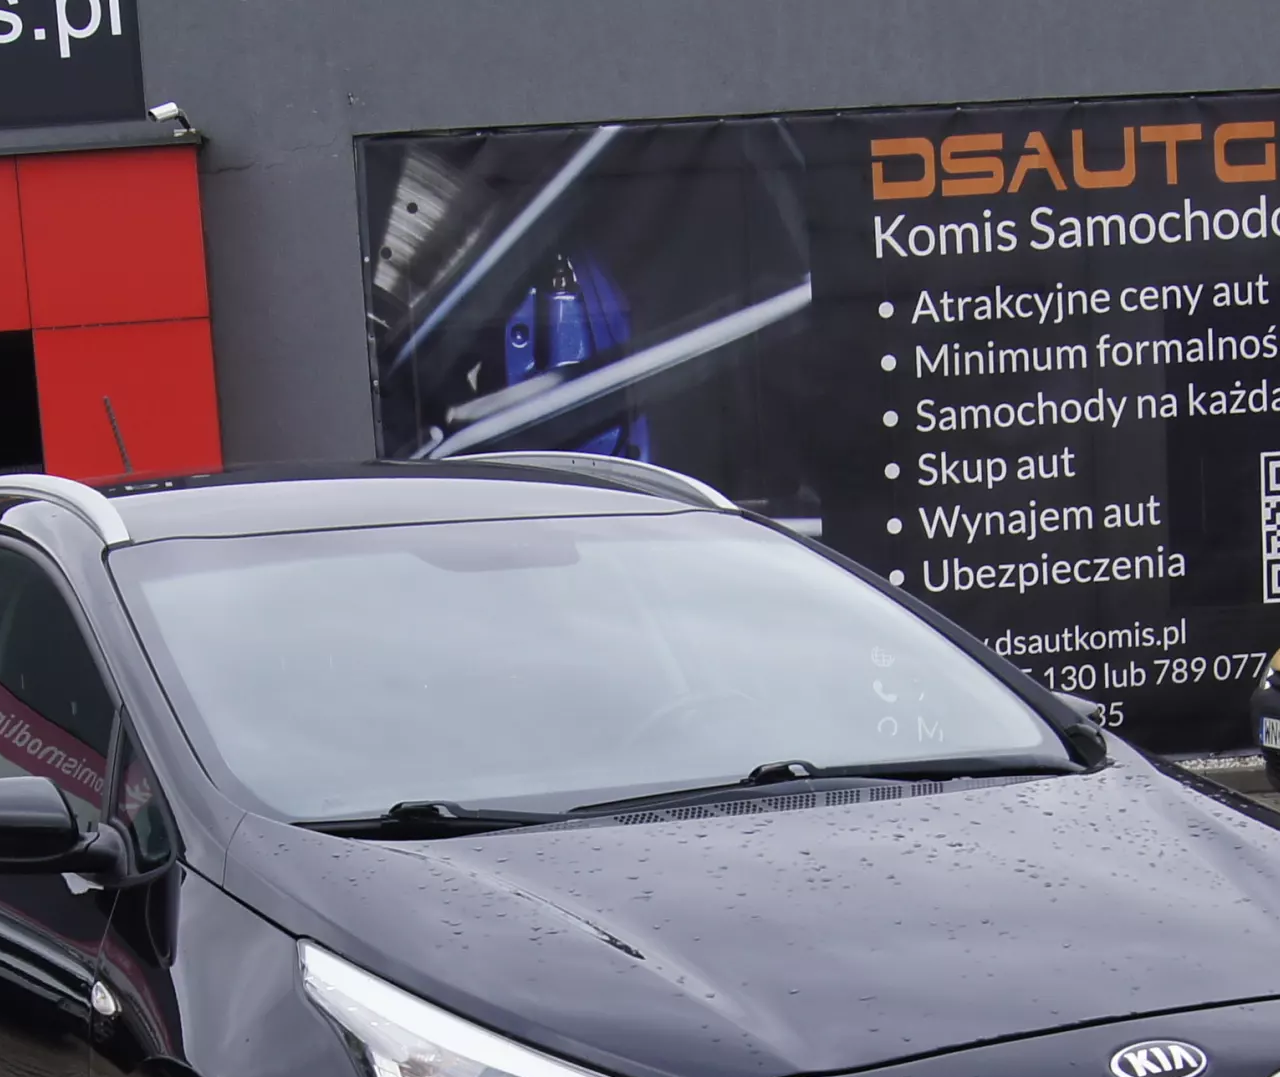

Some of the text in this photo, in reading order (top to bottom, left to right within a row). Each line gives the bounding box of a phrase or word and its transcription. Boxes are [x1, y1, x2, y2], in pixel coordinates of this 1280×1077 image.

[873, 209, 1019, 260] Komis
[911, 273, 1270, 325] Atrakcyjne ceny aut
[915, 341, 1088, 379] Minimum
[916, 387, 1127, 433] Samochody
[1137, 393, 1178, 420] na
[918, 446, 1076, 490] Skup aut
[918, 495, 1161, 545] Wynajem aut
[923, 547, 1186, 594] Ubezpieczenia
[988, 617, 1187, 657] dsautkomis.pl
[1043, 652, 1268, 692] 130 lub 789 077
[1263, 719, 1278, 746] WN
